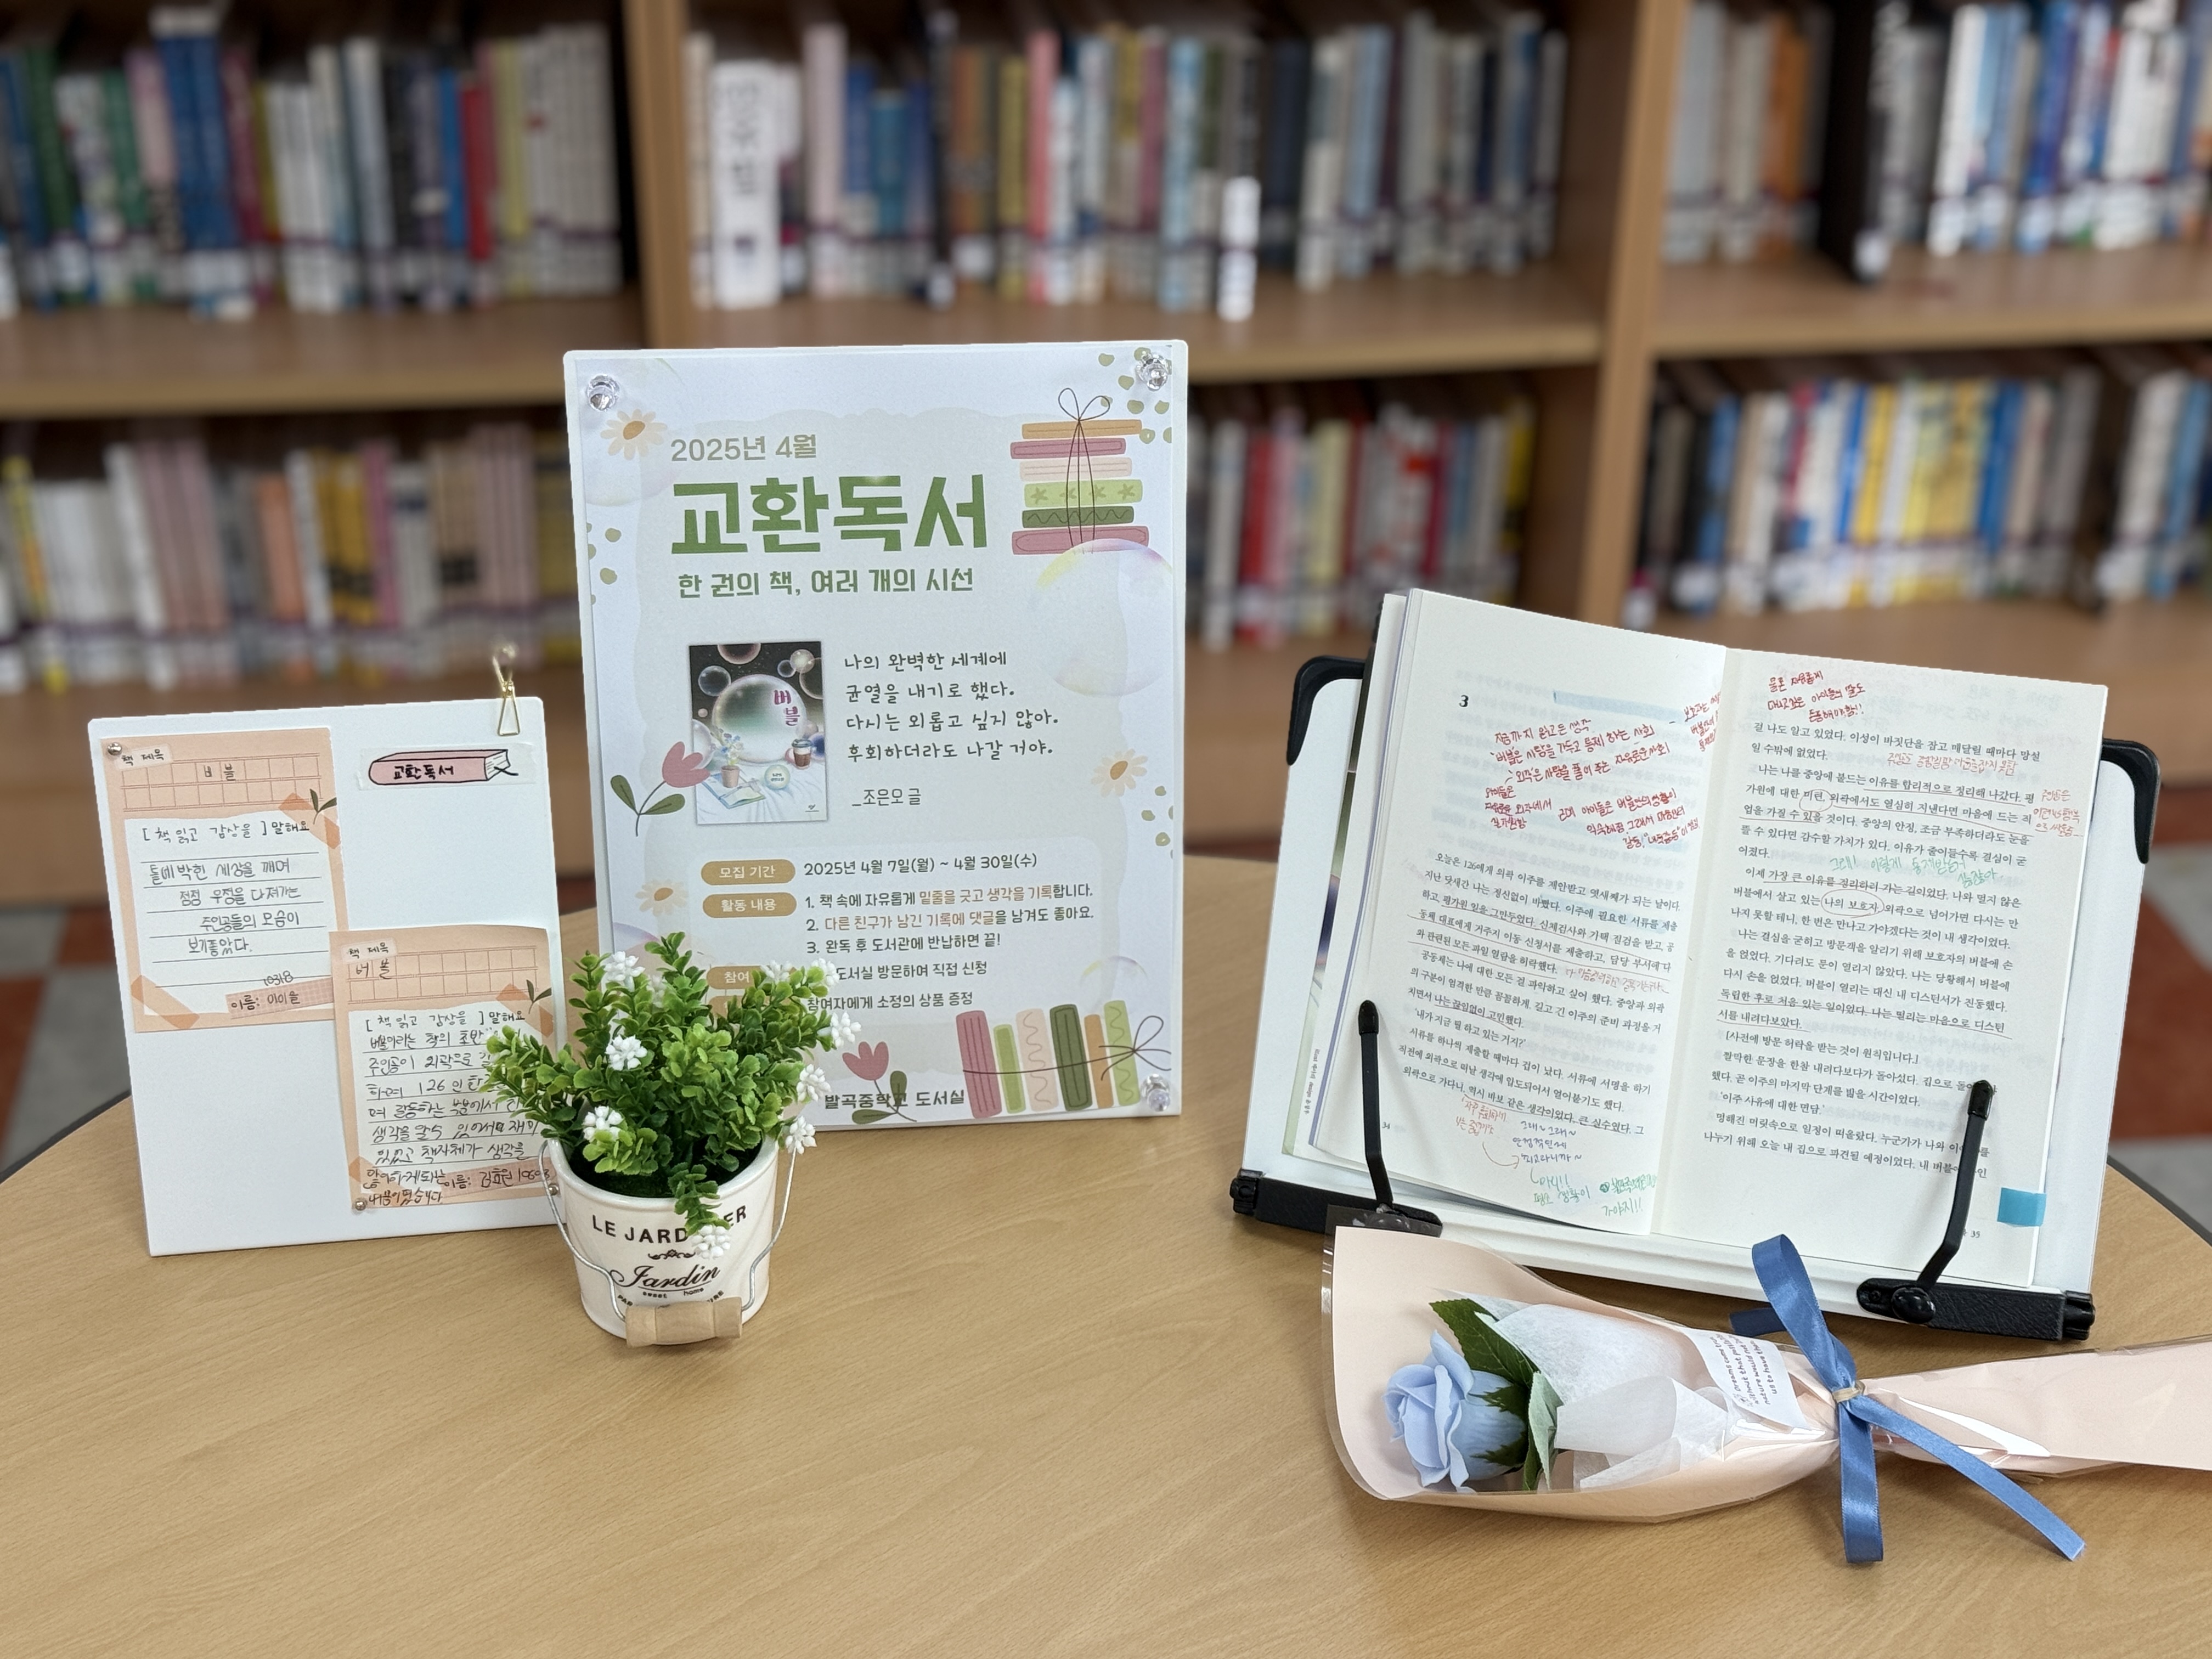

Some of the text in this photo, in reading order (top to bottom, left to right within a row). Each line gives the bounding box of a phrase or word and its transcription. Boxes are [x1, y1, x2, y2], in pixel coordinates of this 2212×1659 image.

[671, 434, 816, 461] 2025년 4월
[671, 474, 988, 554] 교환독서
[679, 568, 973, 598] 한 권의 책, 여러 개의 시선
[845, 652, 1007, 672] 나의 완벽한 세계에
[845, 681, 1014, 704] 균열을 내기로 했다.
[1459, 695, 1469, 707] 3
[774, 690, 800, 726] 버블
[847, 709, 1058, 732] 다시는 외롭고 싶지 않아.
[122, 755, 133, 766] 책
[848, 739, 1053, 762] 후회하더라도 나갈 거야.
[393, 764, 455, 780] 교환독서
[908, 788, 922, 805] 글
[155, 821, 309, 844] 책 읽고 감상을 말해요
[216, 862, 255, 877] 세상을
[719, 866, 775, 879] 모집 기간
[804, 861, 855, 876] 2025년
[861, 860, 882, 873] 4월
[888, 857, 935, 873] 7일(월)
[955, 856, 975, 871] 4월
[981, 853, 1037, 868] 30일(수)
[210, 887, 246, 905] 우정을
[721, 899, 777, 912] 활동 내용
[805, 884, 1093, 909] 1. 책 속에 자유롭게 밑줄을 긋고 생각을 기록합니다.
[806, 906, 1093, 931] 2. 다른 친구가 남긴 기록에 댓글을 남겨도 좋아요.
[806, 933, 1001, 953] 3. 완독 후 도서관에 반납하면 끝!
[837, 961, 987, 980] 도서실 방문하여 직접 신청
[807, 992, 973, 1011] 참여자에게 소정의 상품 증정
[377, 1011, 526, 1029] 책 읽고 감상을 말해요
[916, 1090, 964, 1106] 도서실
[592, 1214, 616, 1237] LE
[609, 1263, 720, 1288] Jardin
